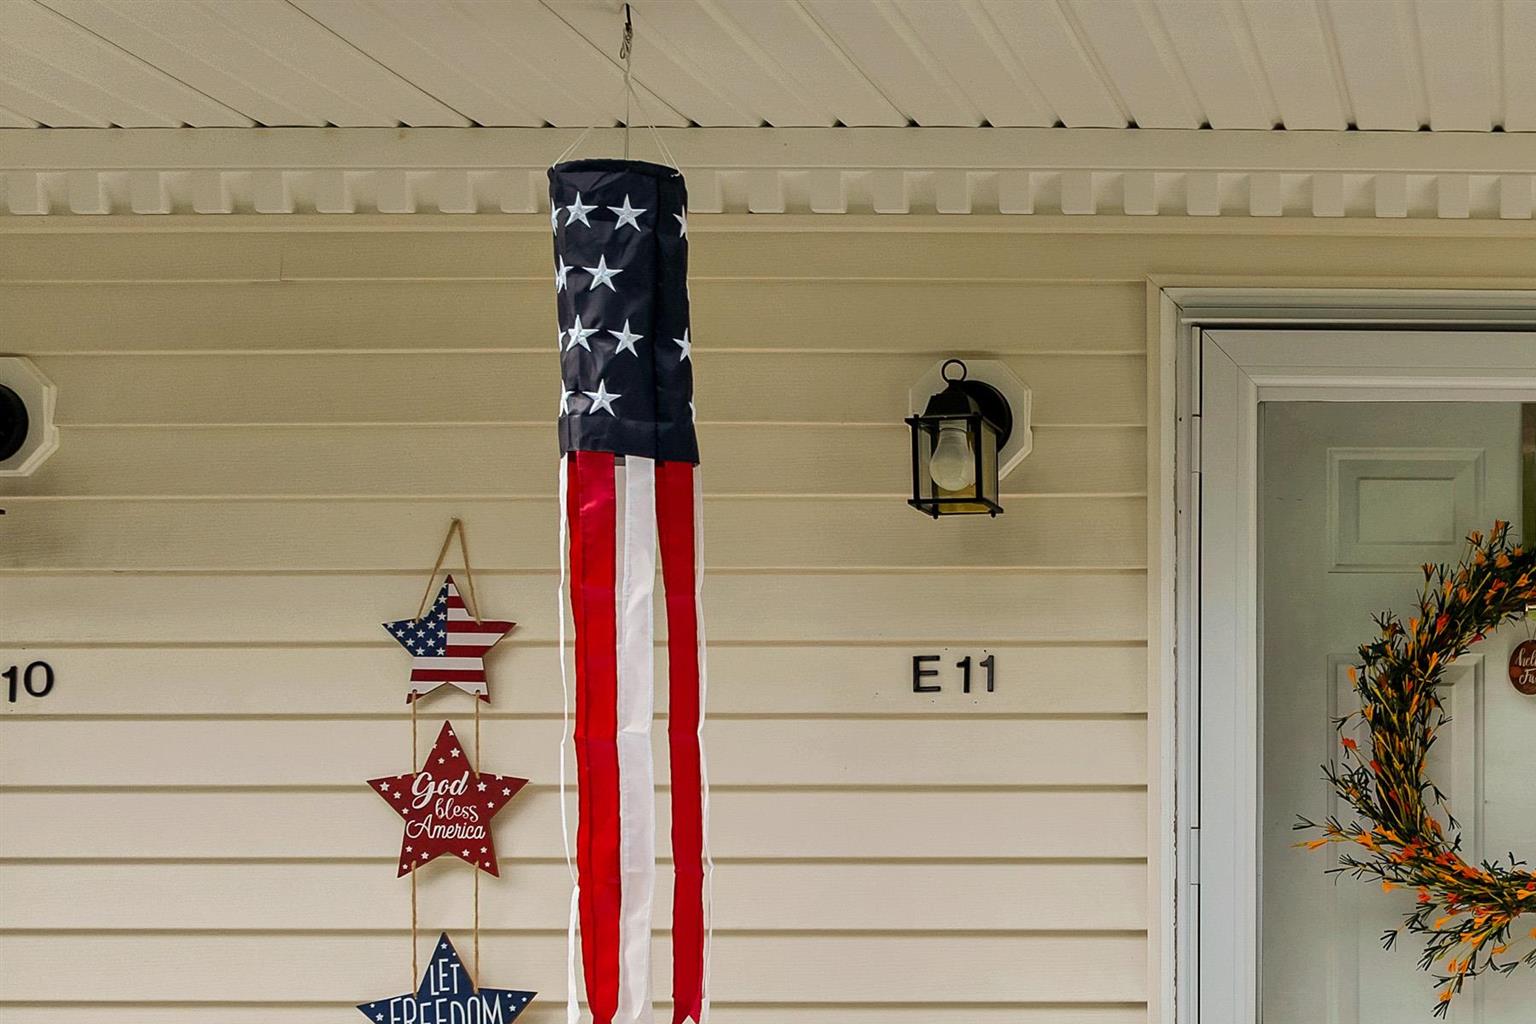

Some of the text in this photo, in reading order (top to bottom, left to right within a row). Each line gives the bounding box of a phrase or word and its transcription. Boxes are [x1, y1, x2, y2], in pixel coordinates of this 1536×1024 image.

[1, 661, 54, 703] 10
[411, 771, 469, 809] God
[406, 814, 486, 839] America
[435, 798, 479, 822] bless
[430, 958, 460, 996] LET
